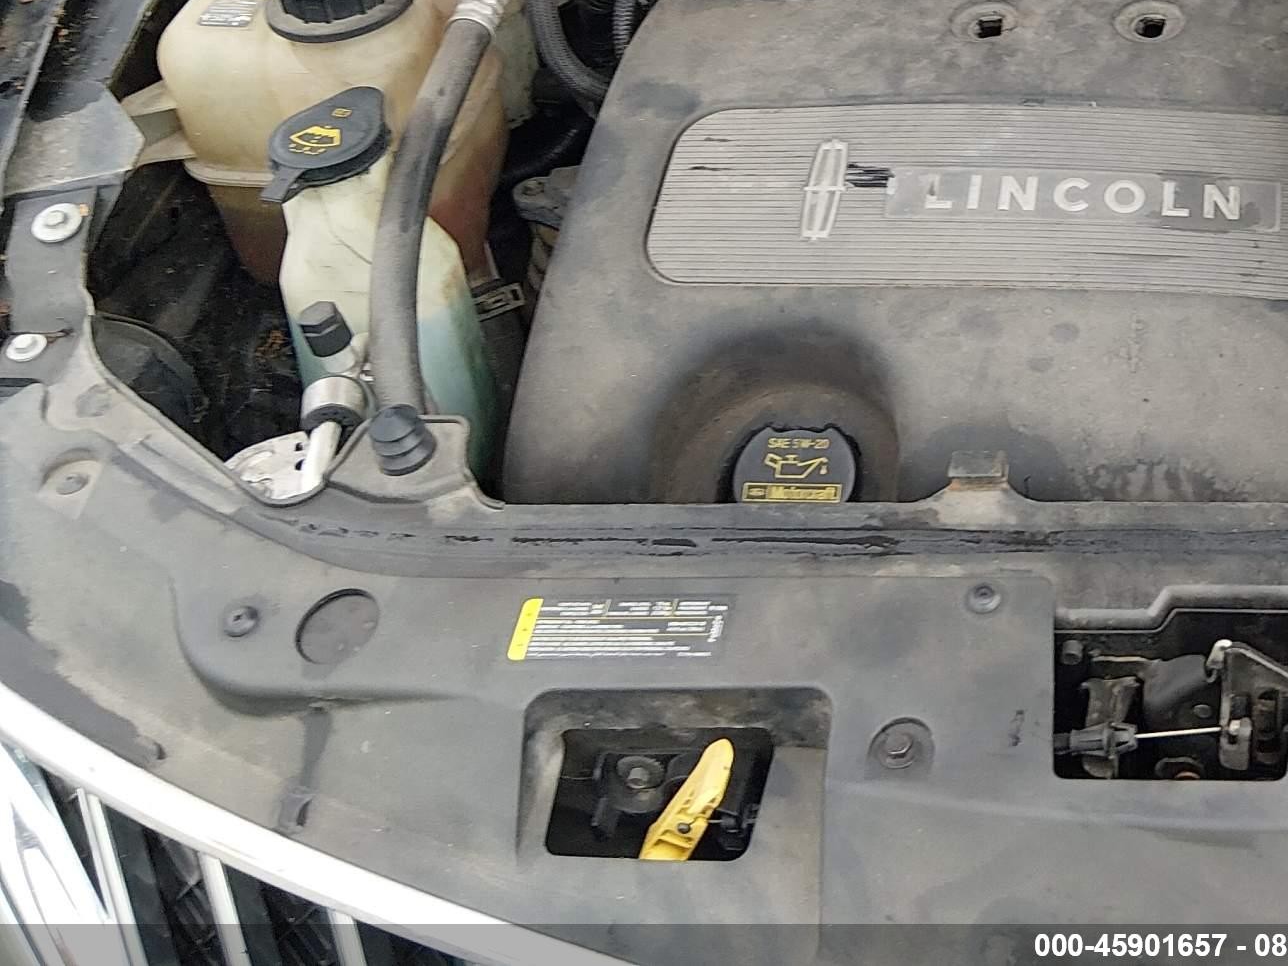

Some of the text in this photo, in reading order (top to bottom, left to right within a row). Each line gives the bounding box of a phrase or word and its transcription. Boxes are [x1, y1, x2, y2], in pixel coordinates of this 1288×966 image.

[923, 173, 1241, 221] LINCOLN
[768, 438, 790, 448] SAE
[767, 485, 837, 500] Motorcraft
